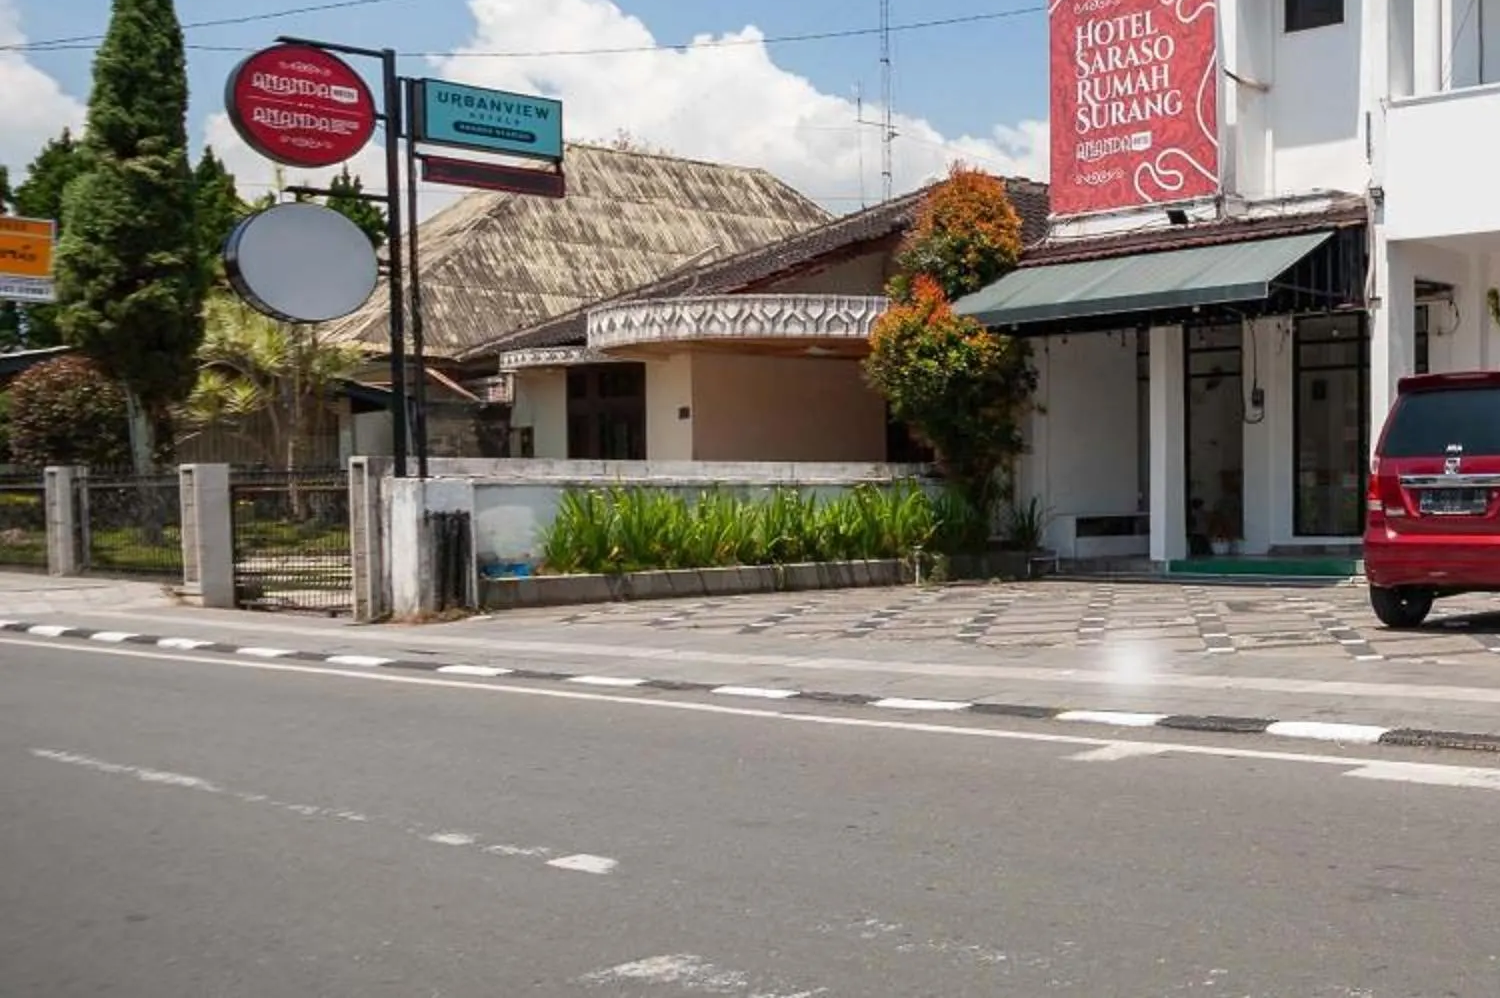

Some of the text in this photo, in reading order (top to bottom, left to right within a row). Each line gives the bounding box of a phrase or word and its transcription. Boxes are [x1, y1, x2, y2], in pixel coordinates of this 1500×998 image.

[1076, 10, 1159, 54] HOTEL
[1075, 34, 1175, 80] SARASO
[252, 71, 330, 99] ANANDA
[437, 90, 550, 120] URBANVIEW
[1076, 63, 1170, 108] RUMAH
[252, 106, 331, 132] ANANDA
[1075, 89, 1183, 135] SURANG
